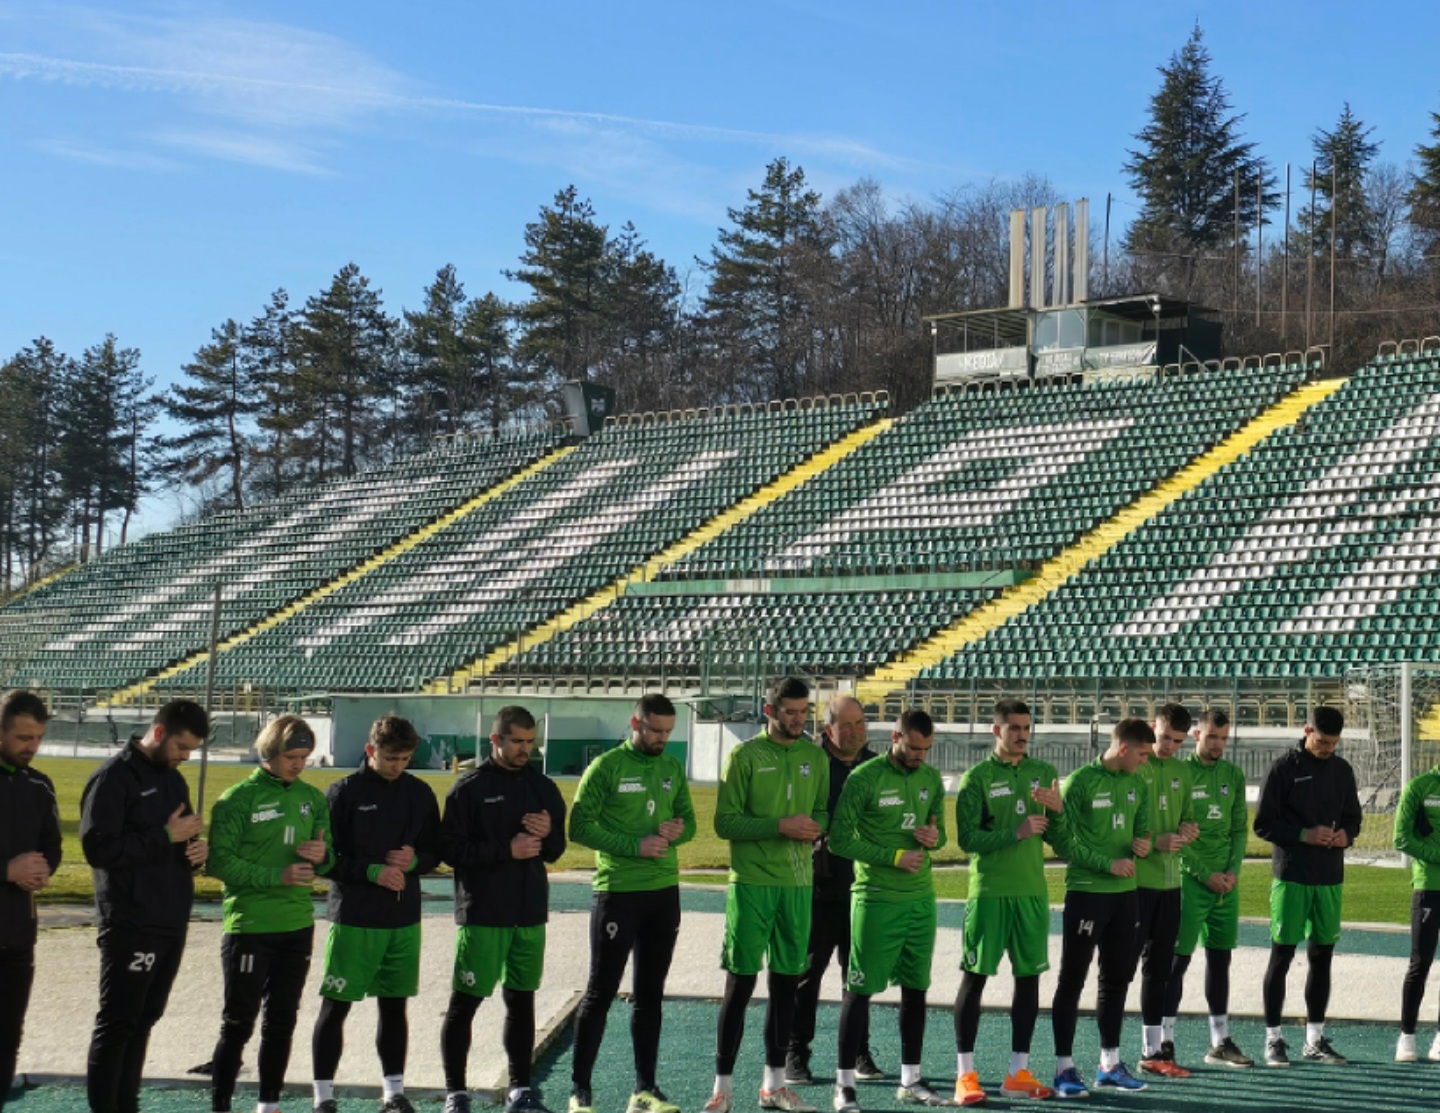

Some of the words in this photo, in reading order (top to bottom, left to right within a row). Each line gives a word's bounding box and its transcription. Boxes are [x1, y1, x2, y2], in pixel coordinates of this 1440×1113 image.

[646, 799, 657, 816] 9
[901, 812, 917, 830] 22
[1112, 813, 1126, 830] 14
[283, 825, 296, 845] 11
[606, 920, 619, 940] 9
[1078, 918, 1095, 937] 14
[128, 952, 156, 972] 29
[240, 953, 255, 974] 11
[325, 974, 347, 993] 99
[850, 970, 865, 987] 22
